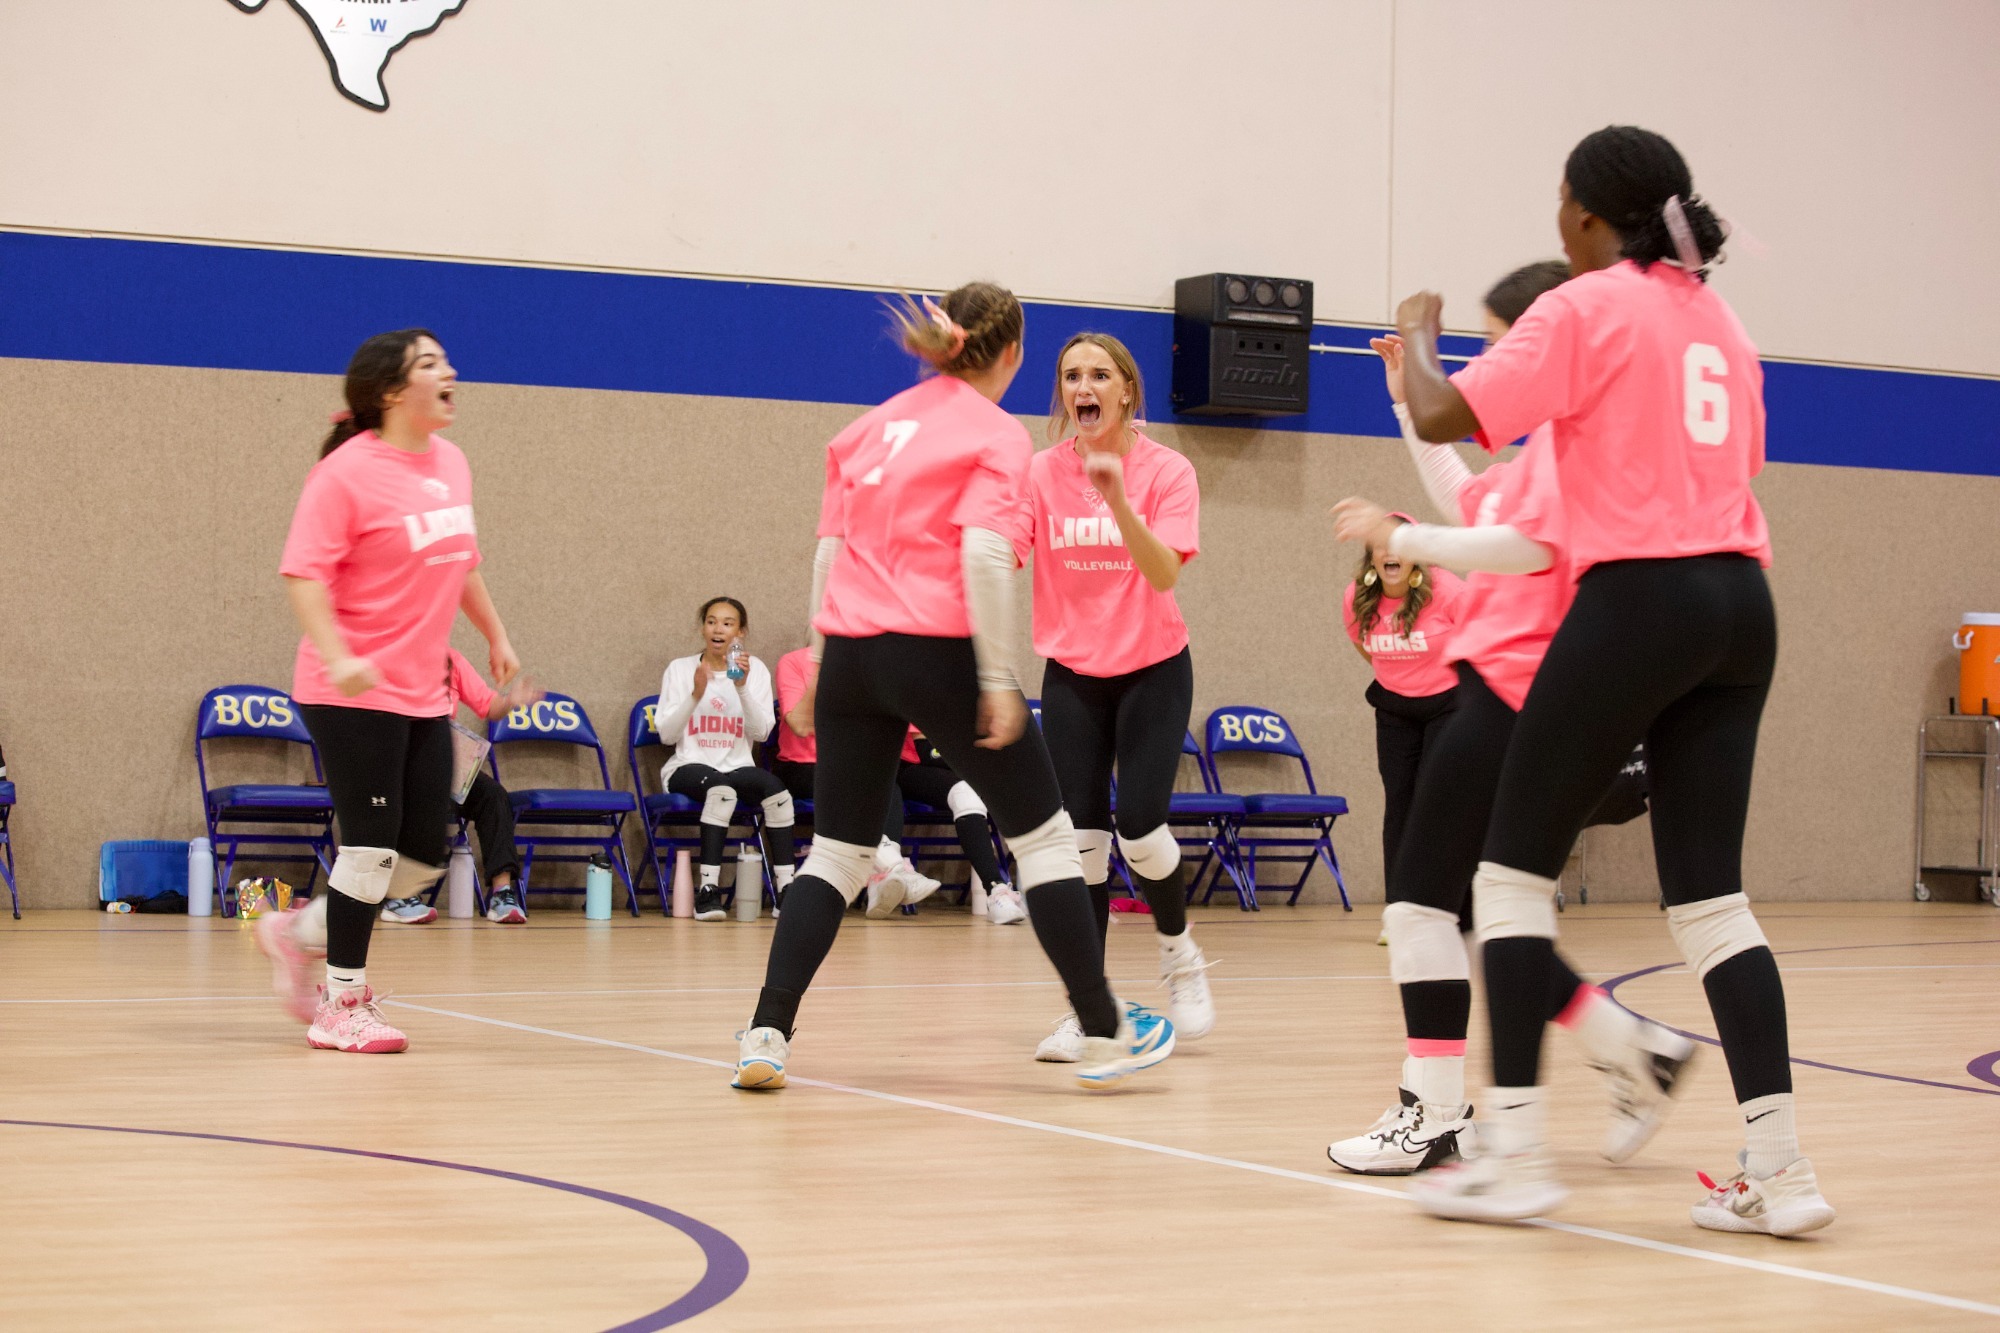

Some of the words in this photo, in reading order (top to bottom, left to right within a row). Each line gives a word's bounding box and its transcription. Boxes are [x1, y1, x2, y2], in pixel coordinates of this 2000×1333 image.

[370, 18, 387, 32] W
[1682, 342, 1730, 446] 6
[861, 420, 920, 485] 7
[1048, 514, 1147, 551] LION
[1063, 560, 1133, 571] VOLLEYBALL
[213, 694, 294, 728] BCS
[508, 700, 580, 732] BCS
[688, 715, 743, 738] LIONS
[1219, 714, 1286, 743] BCS
